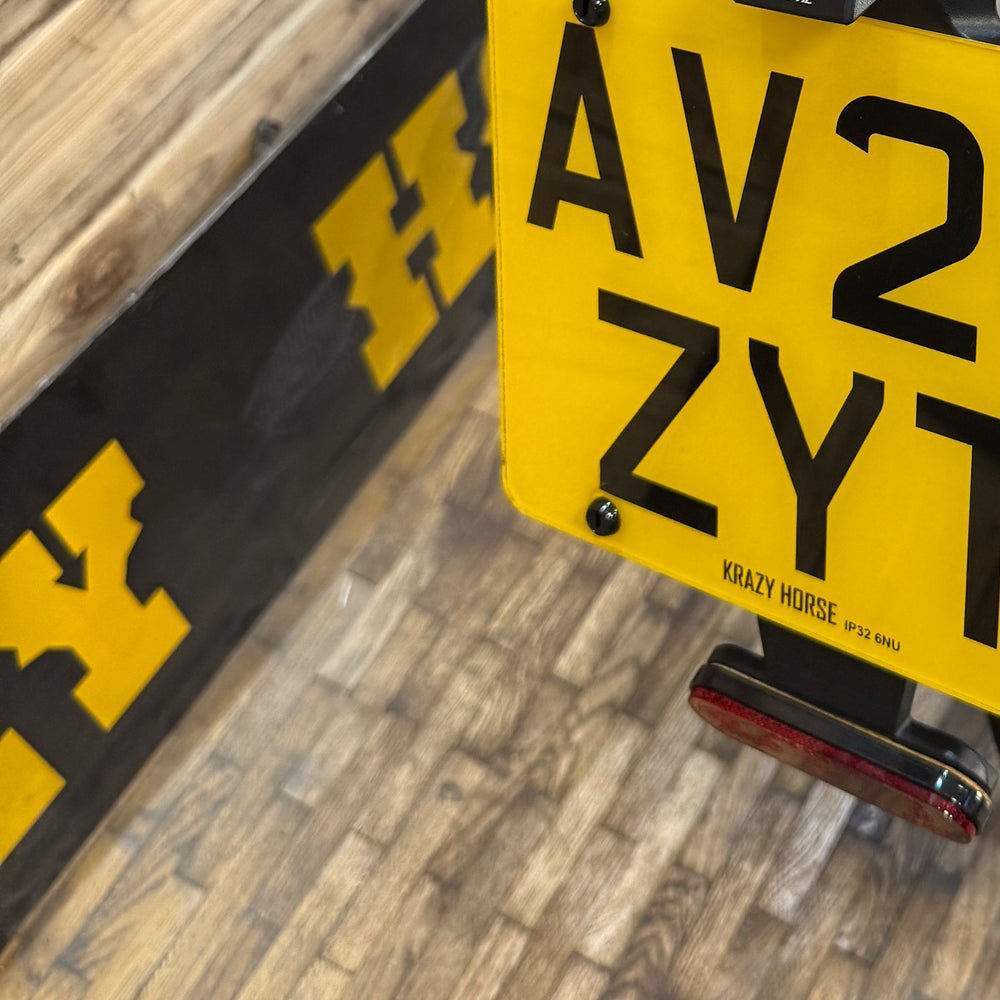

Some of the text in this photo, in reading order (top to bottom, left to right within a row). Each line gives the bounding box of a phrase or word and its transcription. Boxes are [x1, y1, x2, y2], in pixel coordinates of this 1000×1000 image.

[722, 558, 837, 626] KRAZY HORSE
[844, 620, 901, 652] IP32 6NU
